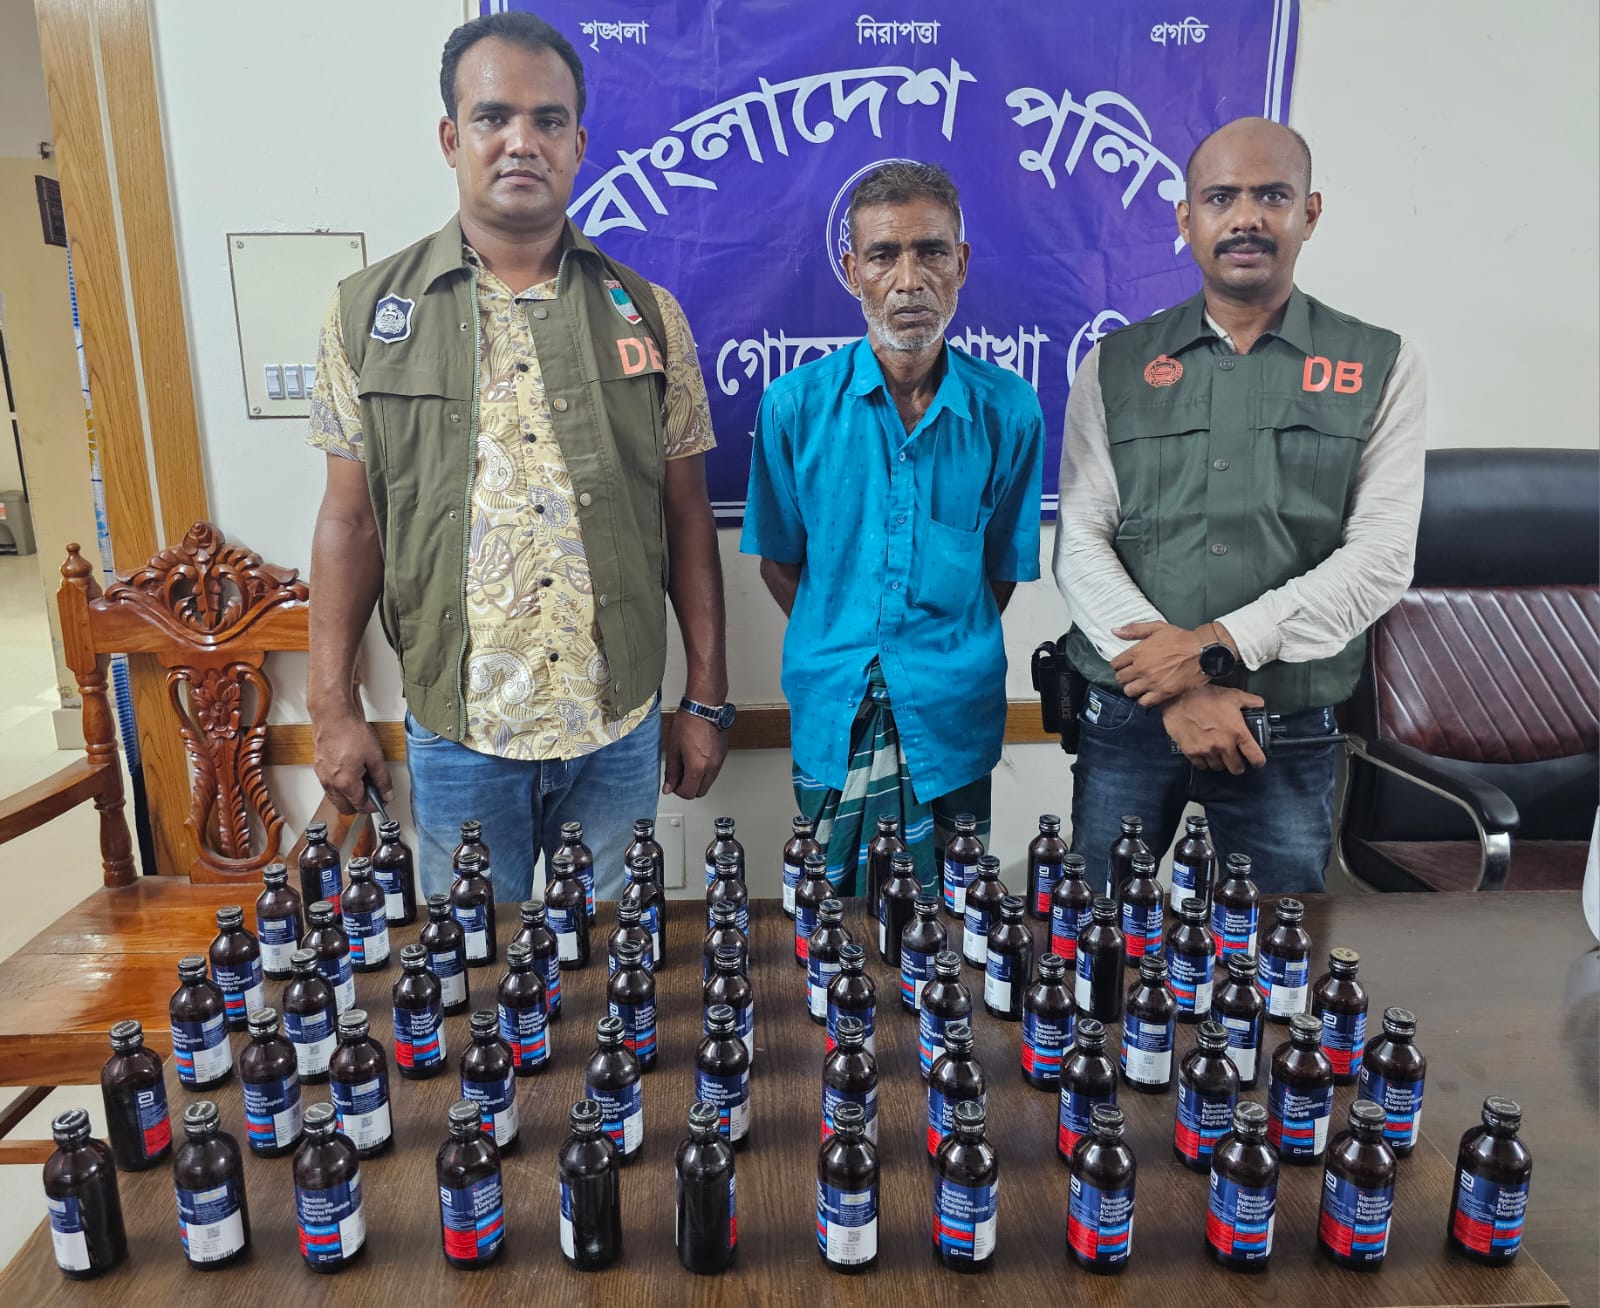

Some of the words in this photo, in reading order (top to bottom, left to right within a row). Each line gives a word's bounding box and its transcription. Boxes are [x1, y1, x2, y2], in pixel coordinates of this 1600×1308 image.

[579, 19, 649, 52] শৃঙ্খলা
[856, 14, 941, 45] নিরাপত্তা
[1150, 16, 1209, 46] প্রগতি
[566, 57, 978, 237] বাংলাদেশ
[1302, 356, 1364, 394] DB
